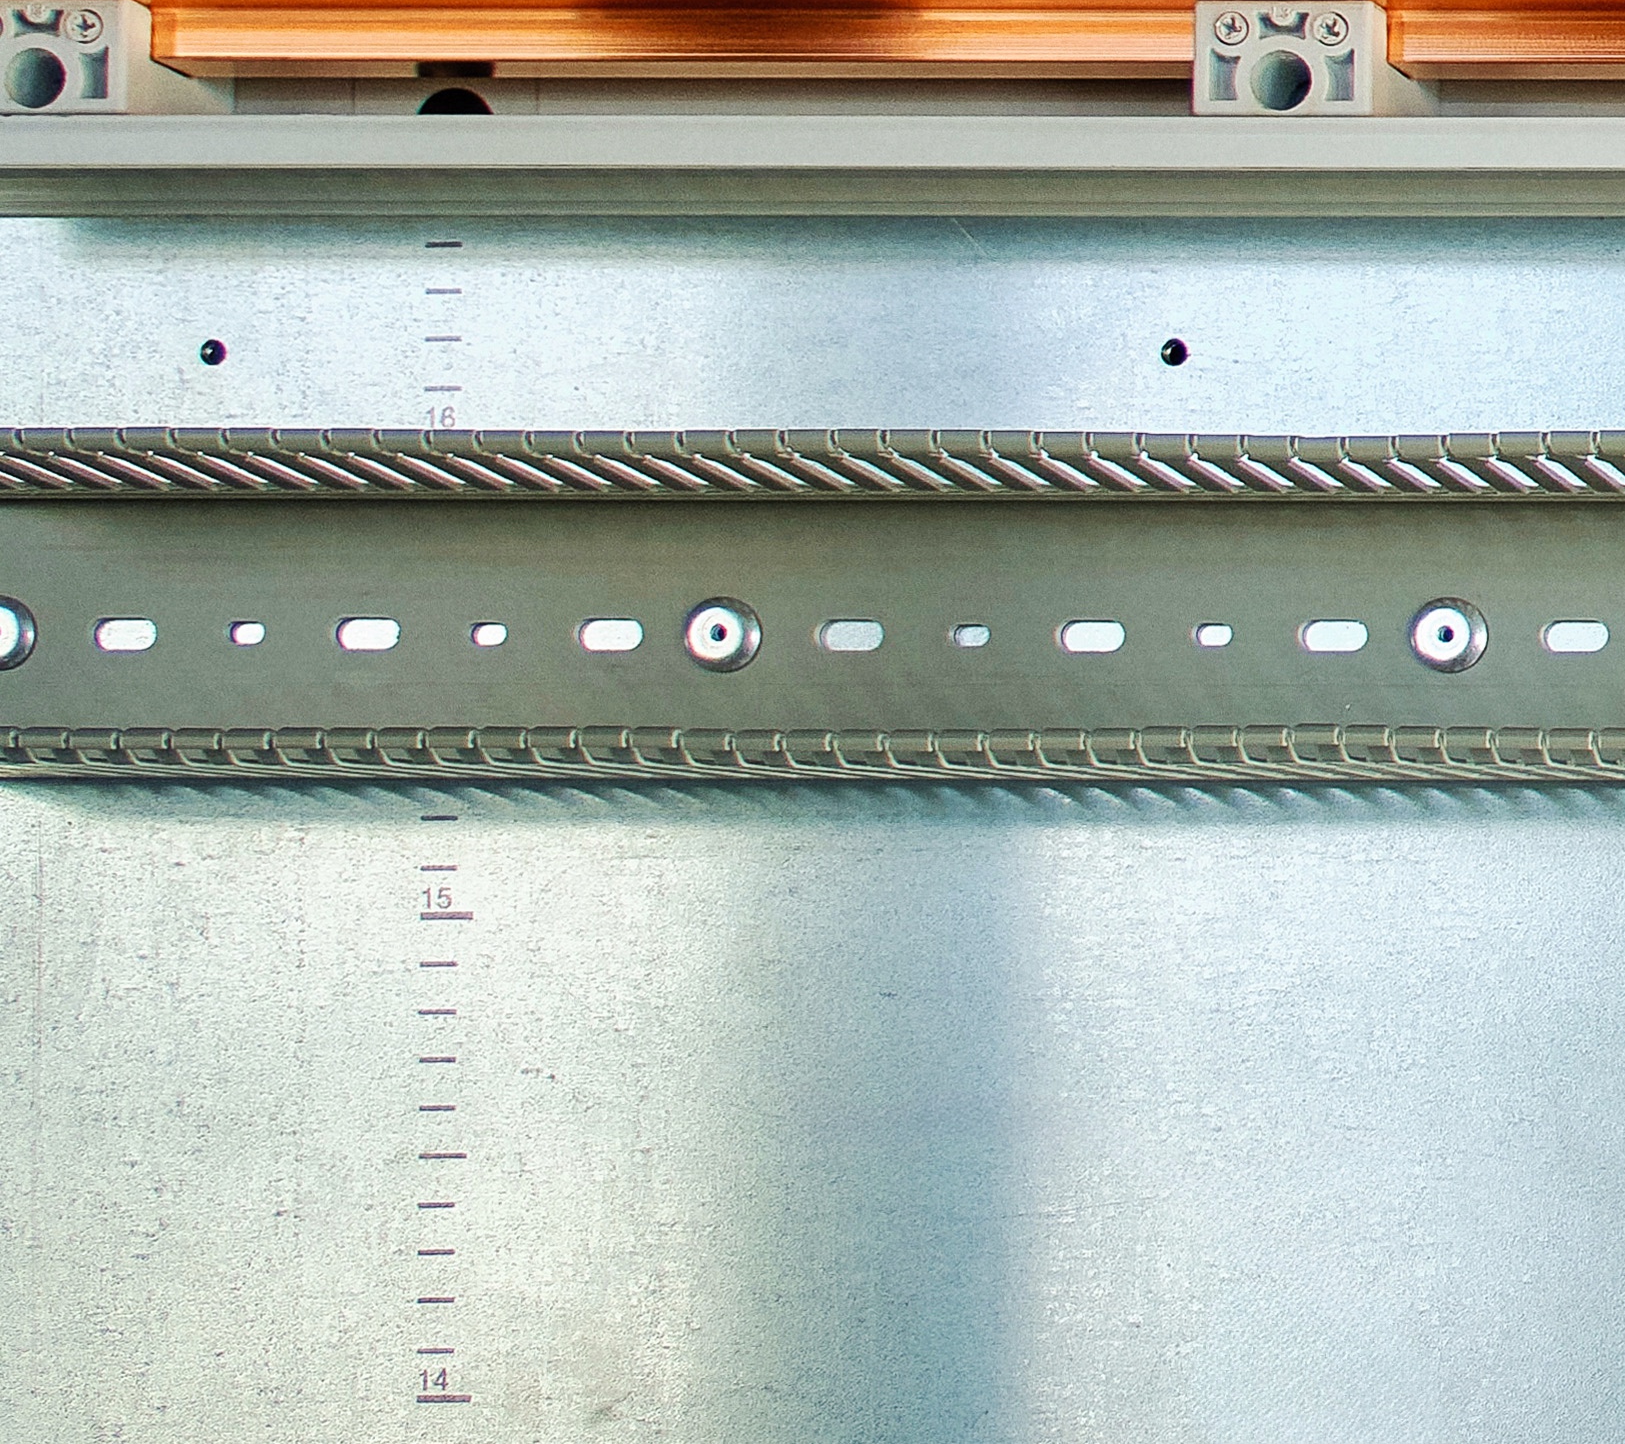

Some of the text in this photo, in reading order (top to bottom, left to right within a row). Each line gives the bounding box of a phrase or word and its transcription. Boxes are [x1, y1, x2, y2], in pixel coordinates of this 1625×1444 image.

[425, 407, 456, 430] 16
[421, 887, 452, 910] 15
[418, 1369, 448, 1392] 14
